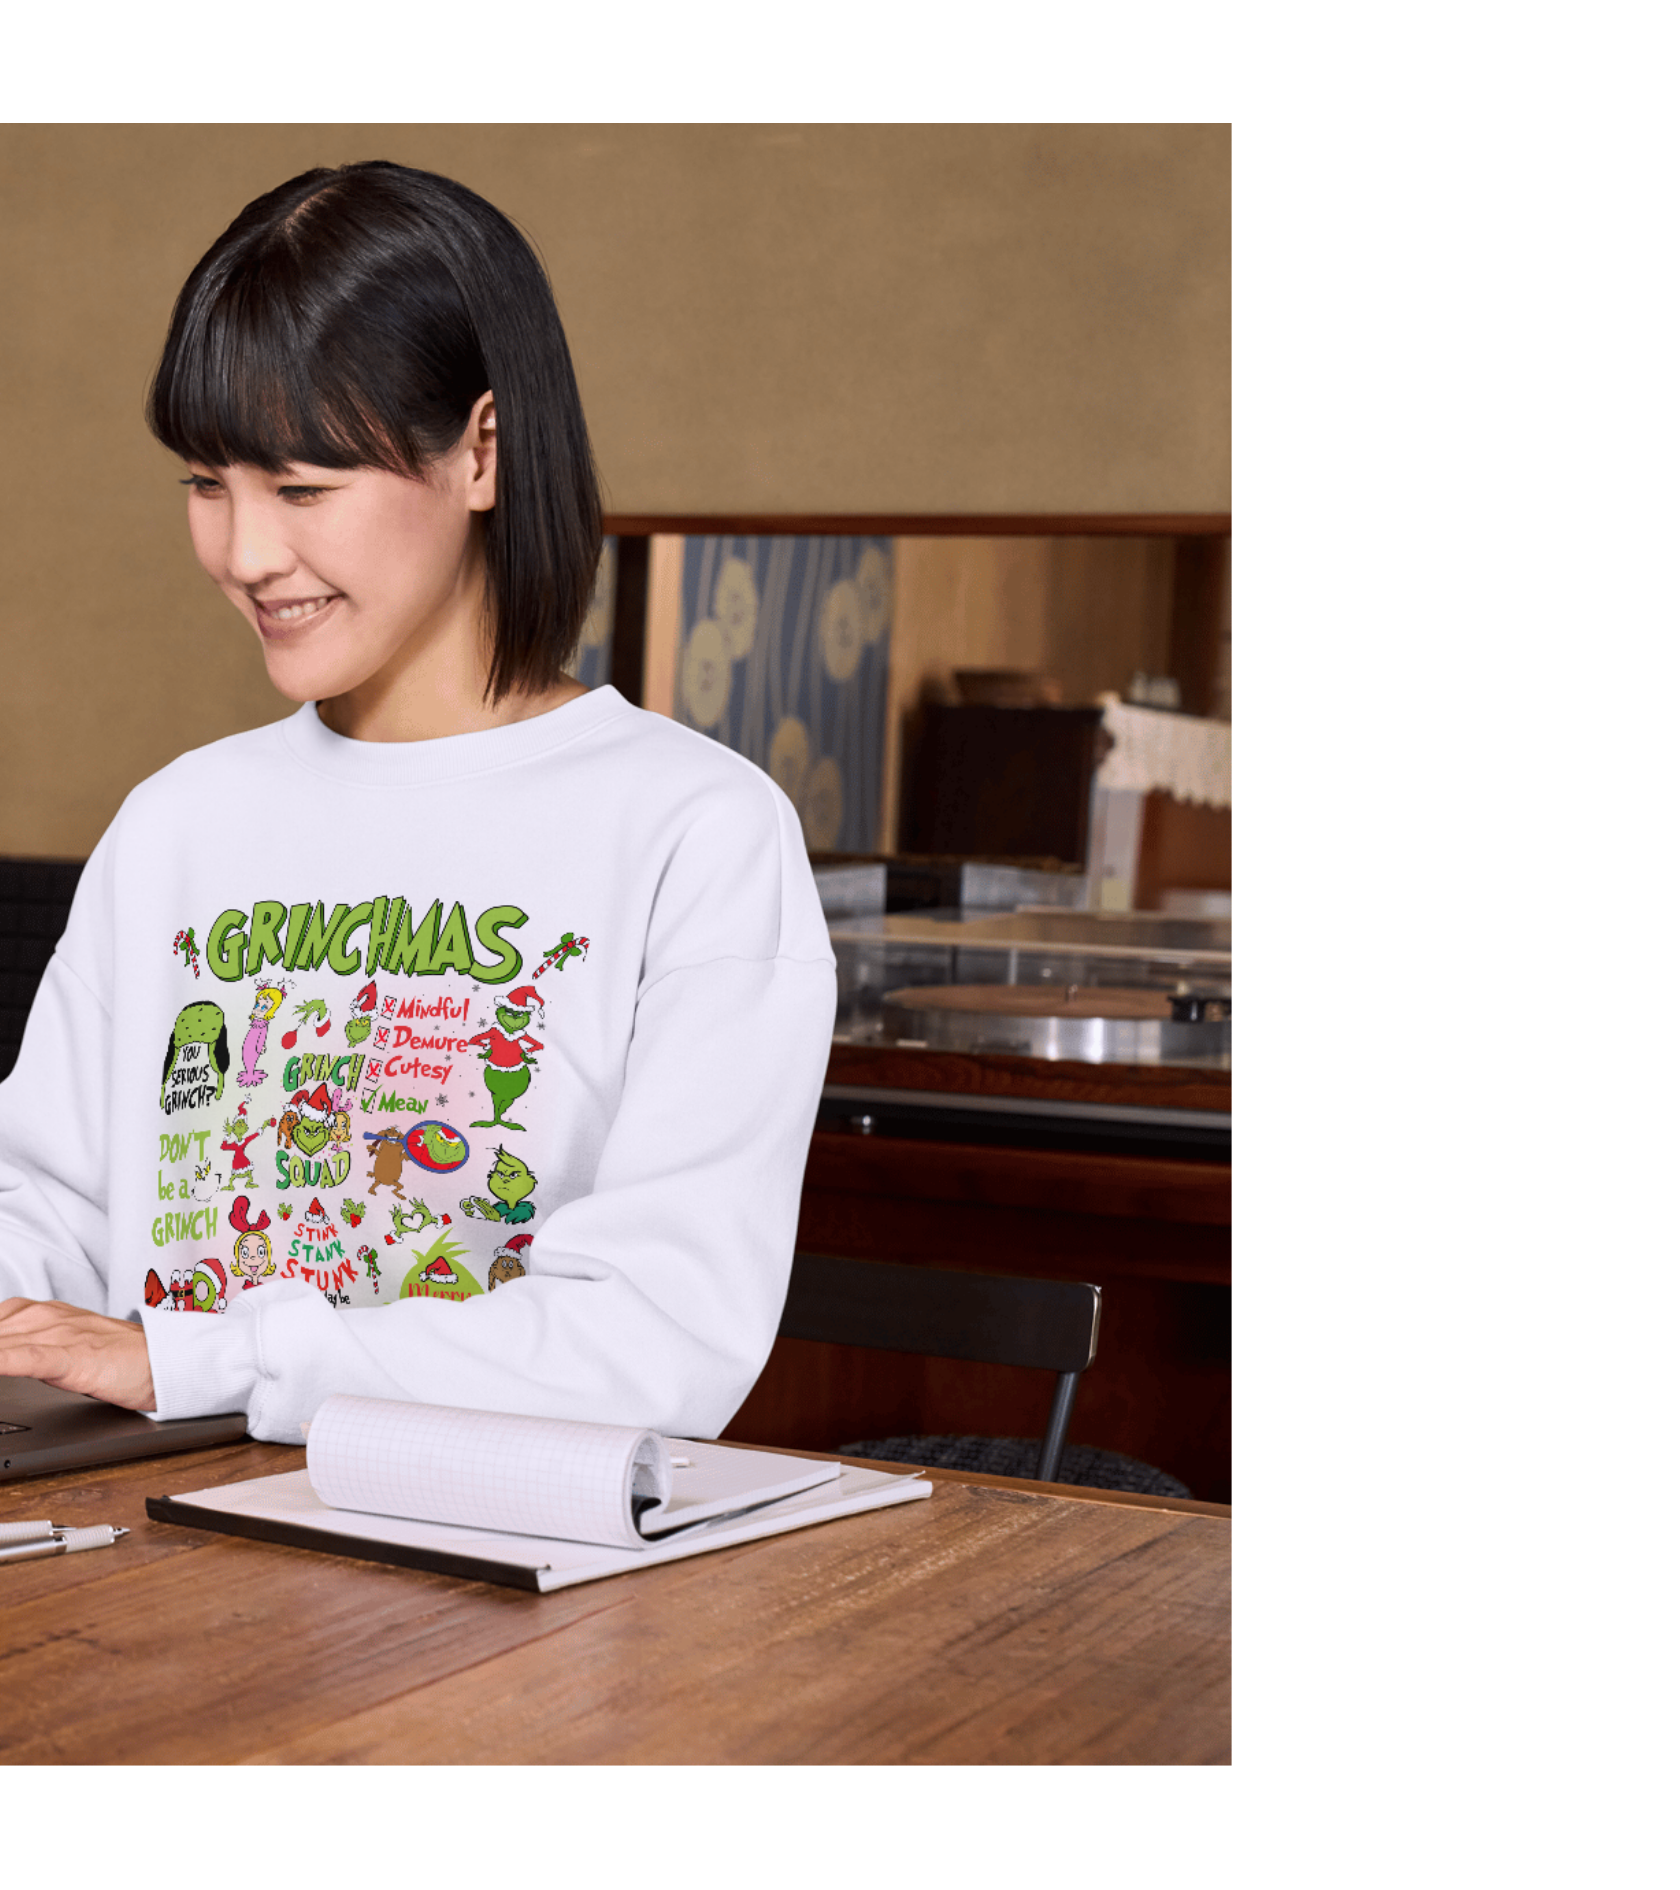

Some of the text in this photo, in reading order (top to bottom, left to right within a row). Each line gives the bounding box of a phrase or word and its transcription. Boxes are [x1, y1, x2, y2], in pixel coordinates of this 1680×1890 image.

[206, 896, 528, 984] GRINCHMAS
[396, 996, 470, 1021] Mindful
[182, 1046, 201, 1062] YOU
[392, 1025, 468, 1053] Demure
[171, 1064, 209, 1088] SERIOUS
[283, 1053, 365, 1092] GRINCH
[384, 1055, 453, 1085] Cutesy
[165, 1085, 216, 1115] GRINCH?
[377, 1090, 429, 1115] Mean
[159, 1129, 211, 1163] DON'T
[158, 1169, 190, 1201] be a
[276, 1150, 350, 1190] SQUAD
[151, 1206, 218, 1247] GRINCH
[294, 1223, 338, 1242] STINK
[288, 1239, 345, 1263] STANK
[280, 1257, 359, 1291] STUNK
